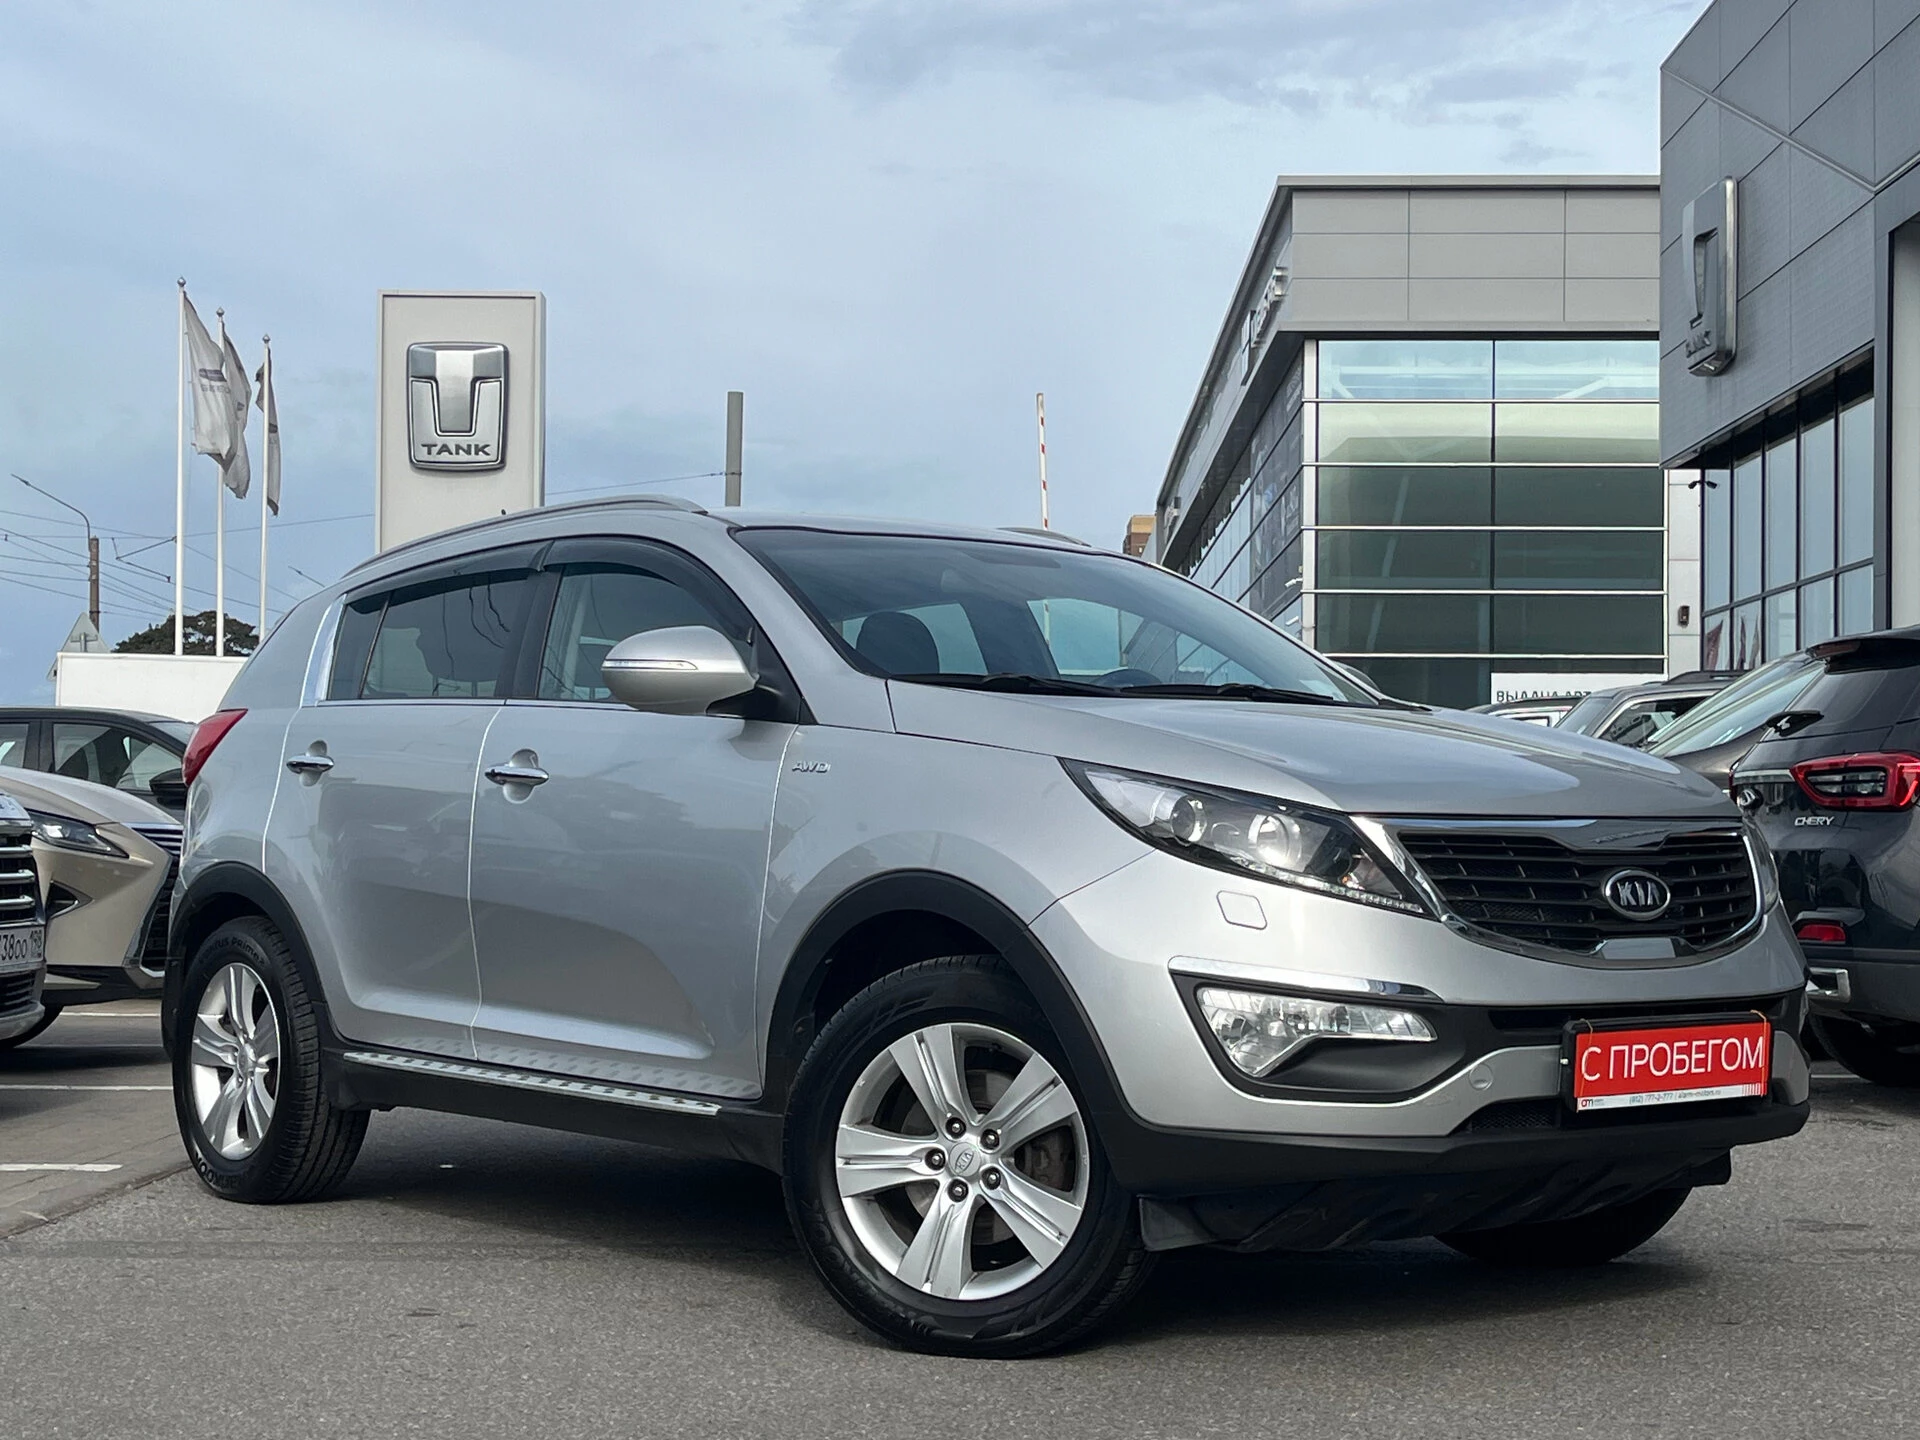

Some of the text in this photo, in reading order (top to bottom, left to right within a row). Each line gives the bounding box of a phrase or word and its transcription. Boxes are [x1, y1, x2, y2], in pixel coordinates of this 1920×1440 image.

[421, 443, 491, 456] TANK
[792, 760, 831, 773] AWD
[1794, 816, 1835, 826] CHERY
[1616, 880, 1661, 906] KIA
[1581, 1036, 1764, 1081] С ПРОБЕГОМ
